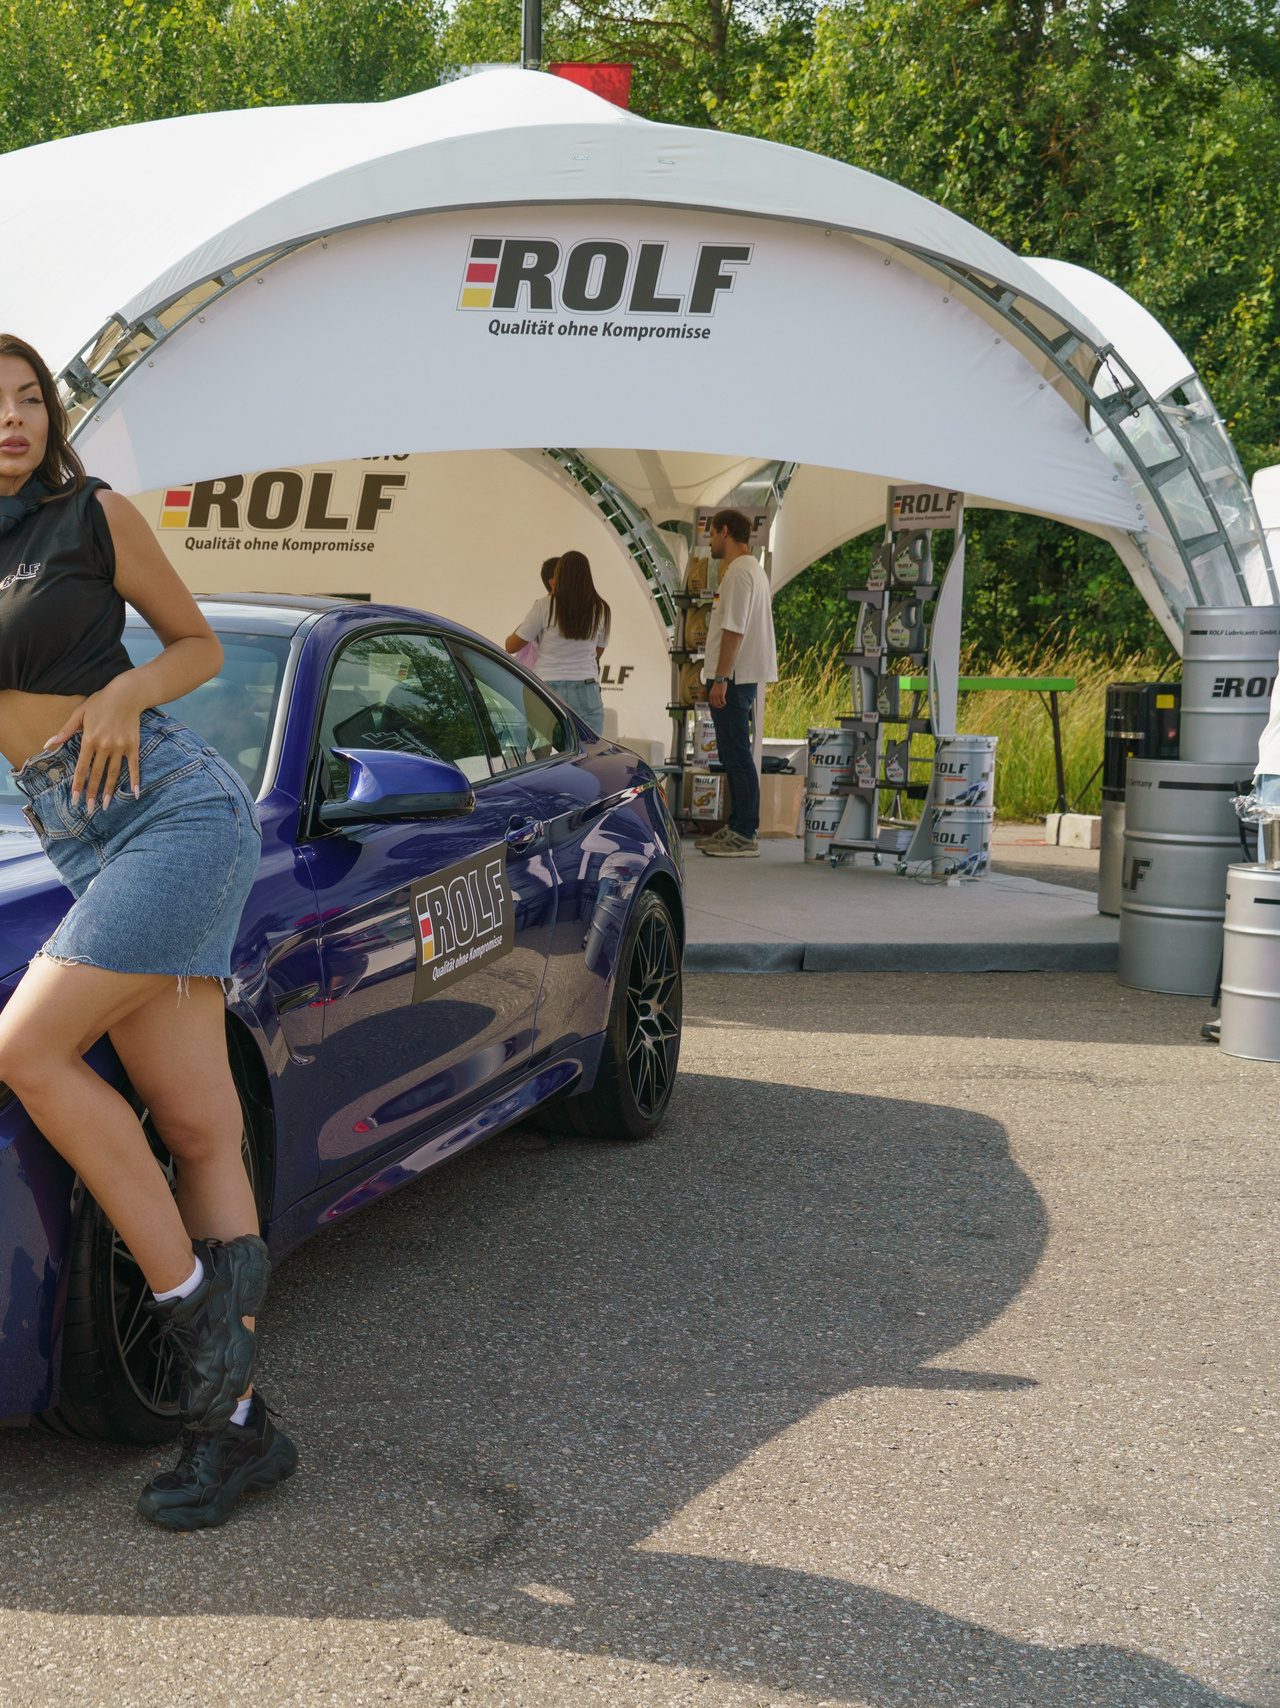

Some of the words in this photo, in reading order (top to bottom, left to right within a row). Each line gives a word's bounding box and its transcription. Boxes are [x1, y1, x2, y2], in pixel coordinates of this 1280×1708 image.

[491, 238, 753, 315] ROLF
[488, 319, 554, 337] Qualität
[558, 320, 598, 337] ohne
[601, 321, 711, 341] Kompromisse
[187, 471, 408, 531] ROLF
[900, 492, 958, 514] ROLF
[184, 536, 241, 550] Qualität
[244, 537, 279, 551] ohne
[282, 538, 375, 554] Kompromisse
[600, 665, 634, 684] LF
[1222, 677, 1276, 698] RO
[815, 755, 855, 766] ROLF
[933, 832, 971, 844] ROLF
[1122, 856, 1152, 892] LF
[426, 859, 505, 957] ROLF
[432, 958, 455, 981] Qualität
[455, 952, 469, 968] ohne
[469, 934, 503, 961] Kompromisse
